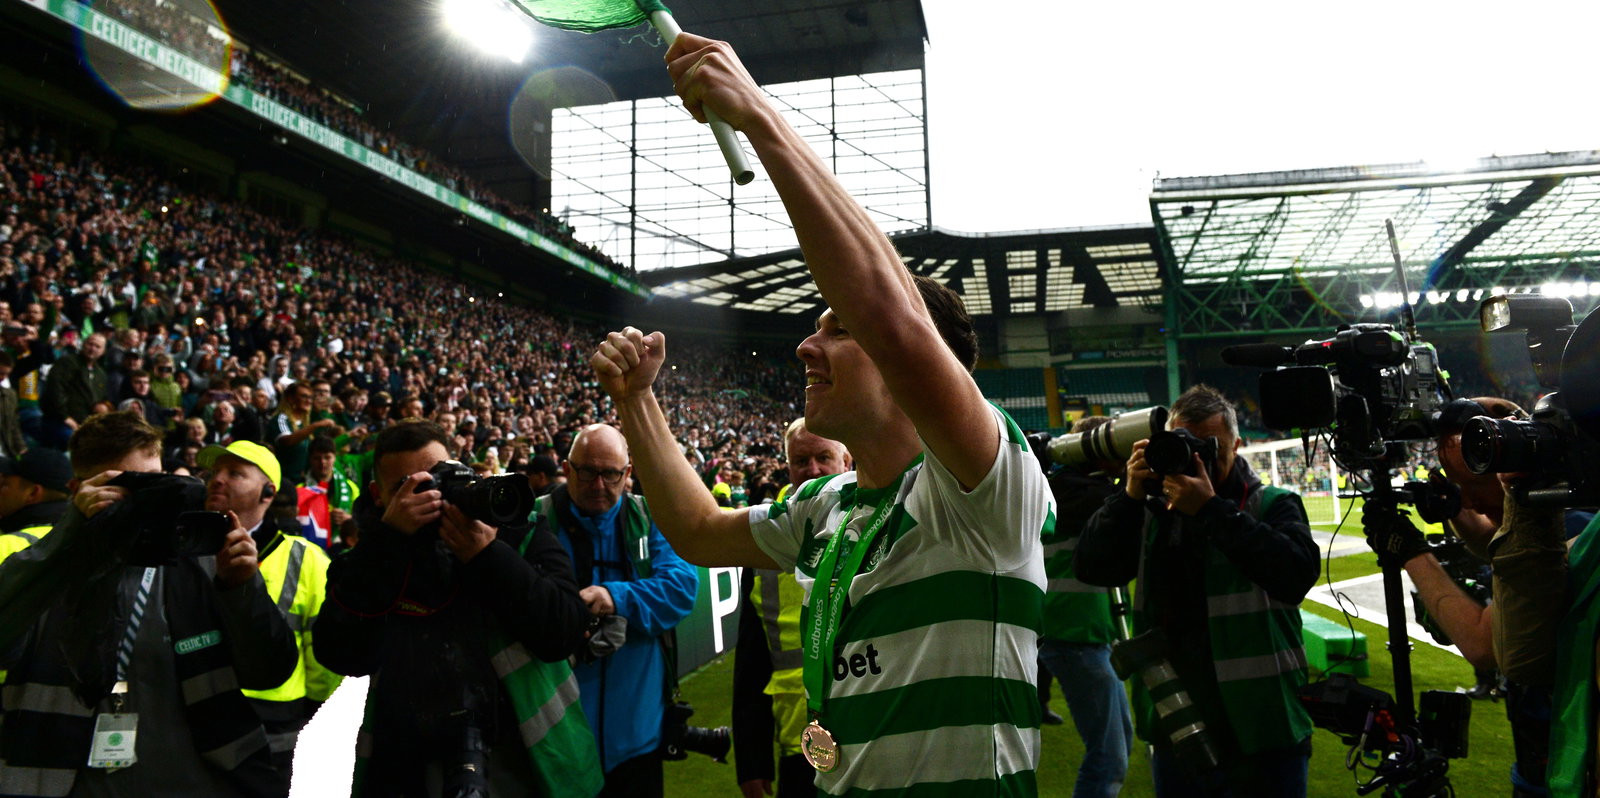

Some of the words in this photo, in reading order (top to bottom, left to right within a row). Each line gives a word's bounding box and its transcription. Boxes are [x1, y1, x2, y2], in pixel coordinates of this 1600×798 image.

[92, 11, 222, 95] CELTICFC.NET/STO
[179, 637, 202, 652] CELTIC
[709, 566, 744, 654] P
[810, 598, 824, 660] Ladbrokes
